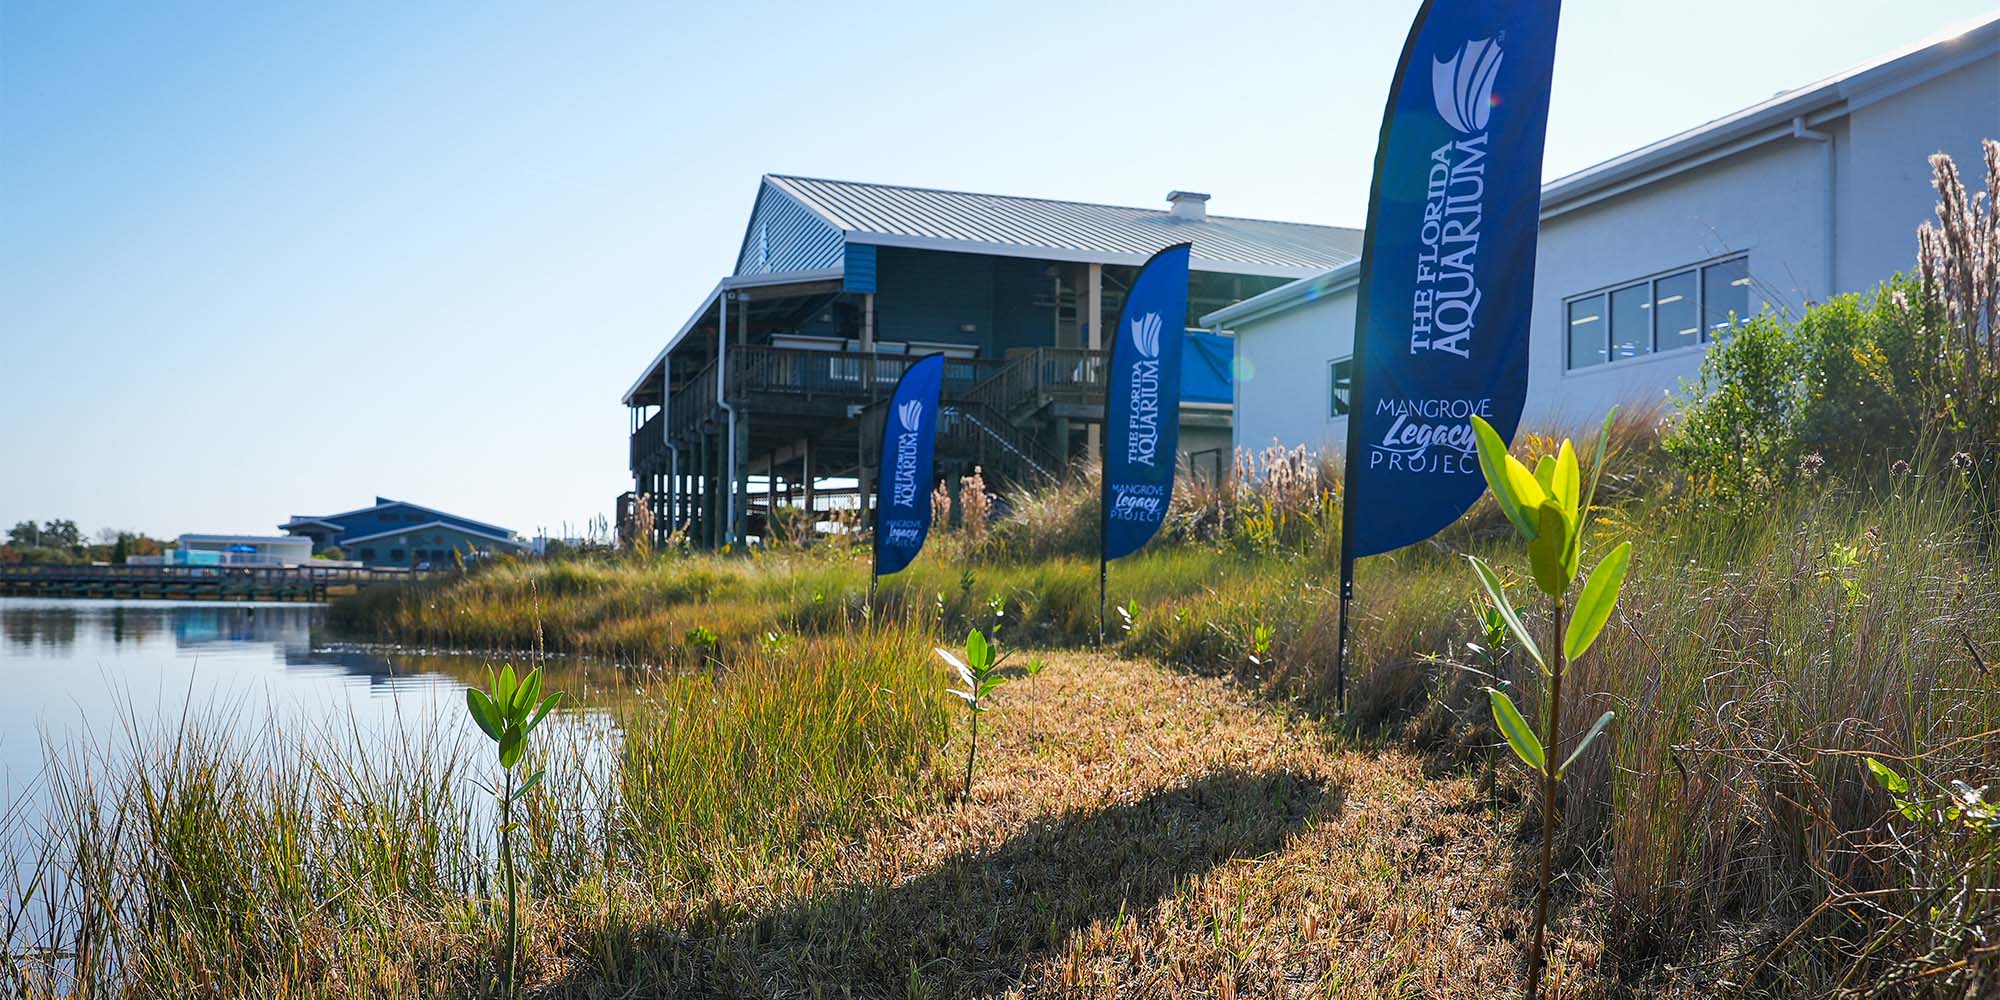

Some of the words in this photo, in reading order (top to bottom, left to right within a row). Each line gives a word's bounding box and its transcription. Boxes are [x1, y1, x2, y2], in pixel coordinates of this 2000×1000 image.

[1416, 140, 1453, 284] FLORIDA
[1432, 132, 1488, 359] AQUARIUM
[1410, 288, 1433, 354] THE
[1129, 360, 1142, 429] FLORIDA
[1138, 359, 1159, 467] AQUARIUM
[1376, 398, 1493, 418] MANGROVE
[901, 432, 918, 508] AQUARIUM
[1128, 431, 1138, 464] THE
[1370, 451, 1474, 474] PROJEC
[1382, 414, 1477, 460] Legacy
[1116, 492, 1160, 514] Legacy
